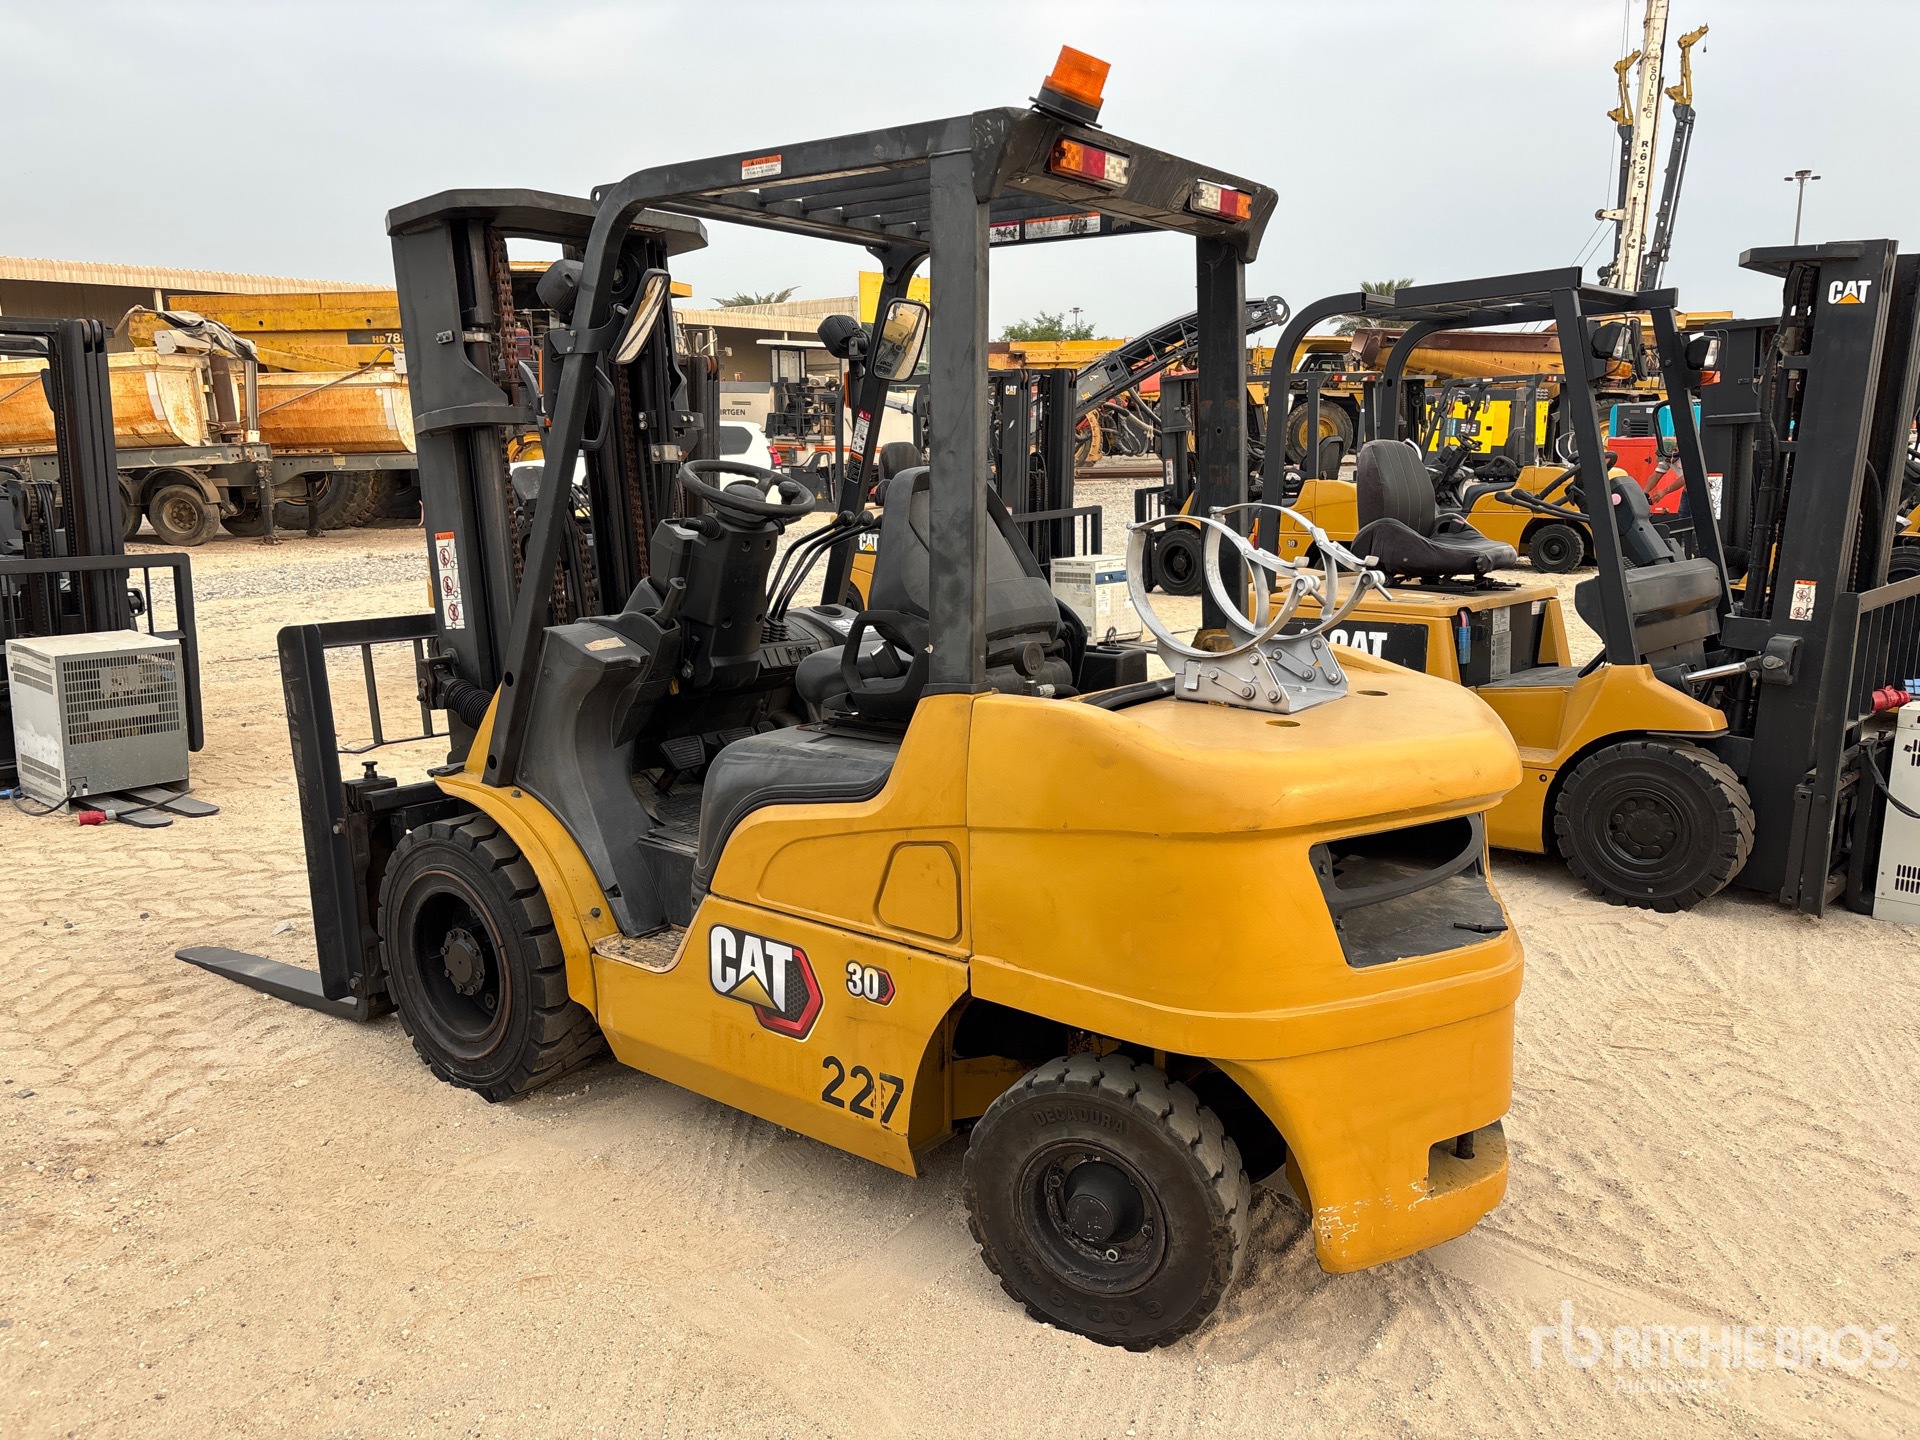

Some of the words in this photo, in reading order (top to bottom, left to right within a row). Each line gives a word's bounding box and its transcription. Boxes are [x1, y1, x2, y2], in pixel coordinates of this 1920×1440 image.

[1645, 66, 1657, 118] SOILMEC
[1828, 280, 1872, 304] CAT
[372, 333, 404, 343] HD78
[1005, 385, 1017, 395] CAT
[858, 533, 879, 551] CAT
[710, 926, 793, 1013] CAT
[847, 962, 879, 1000] 30
[822, 1056, 904, 1123] 227
[1032, 1106, 1125, 1135] DECADURA
